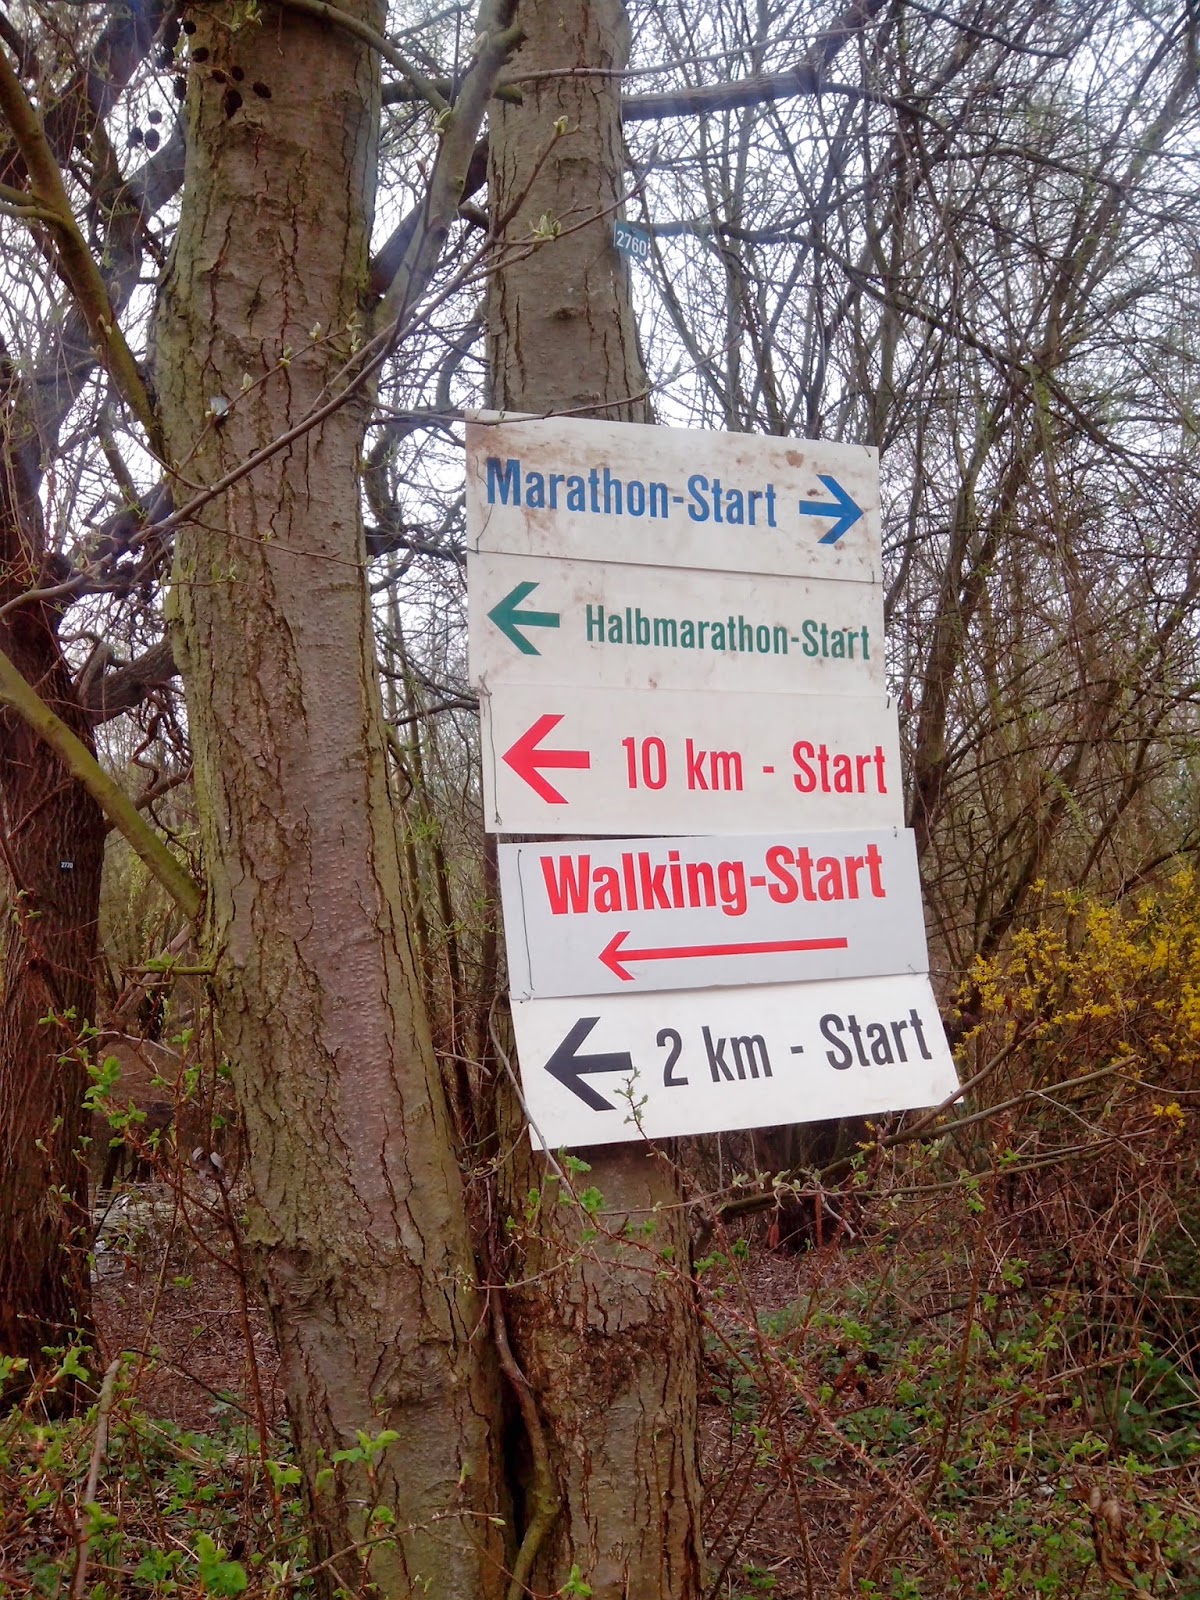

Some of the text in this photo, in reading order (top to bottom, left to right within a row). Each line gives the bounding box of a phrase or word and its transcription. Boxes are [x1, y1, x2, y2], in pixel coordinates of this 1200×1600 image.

[616, 230, 647, 256] 2760
[487, 457, 777, 527] Marathon-Start
[585, 604, 871, 660] Halbmarathon-Start
[621, 736, 888, 794] 10 km - Start
[539, 843, 887, 917] Walking-Start
[656, 1008, 933, 1088] 2 km - Start
